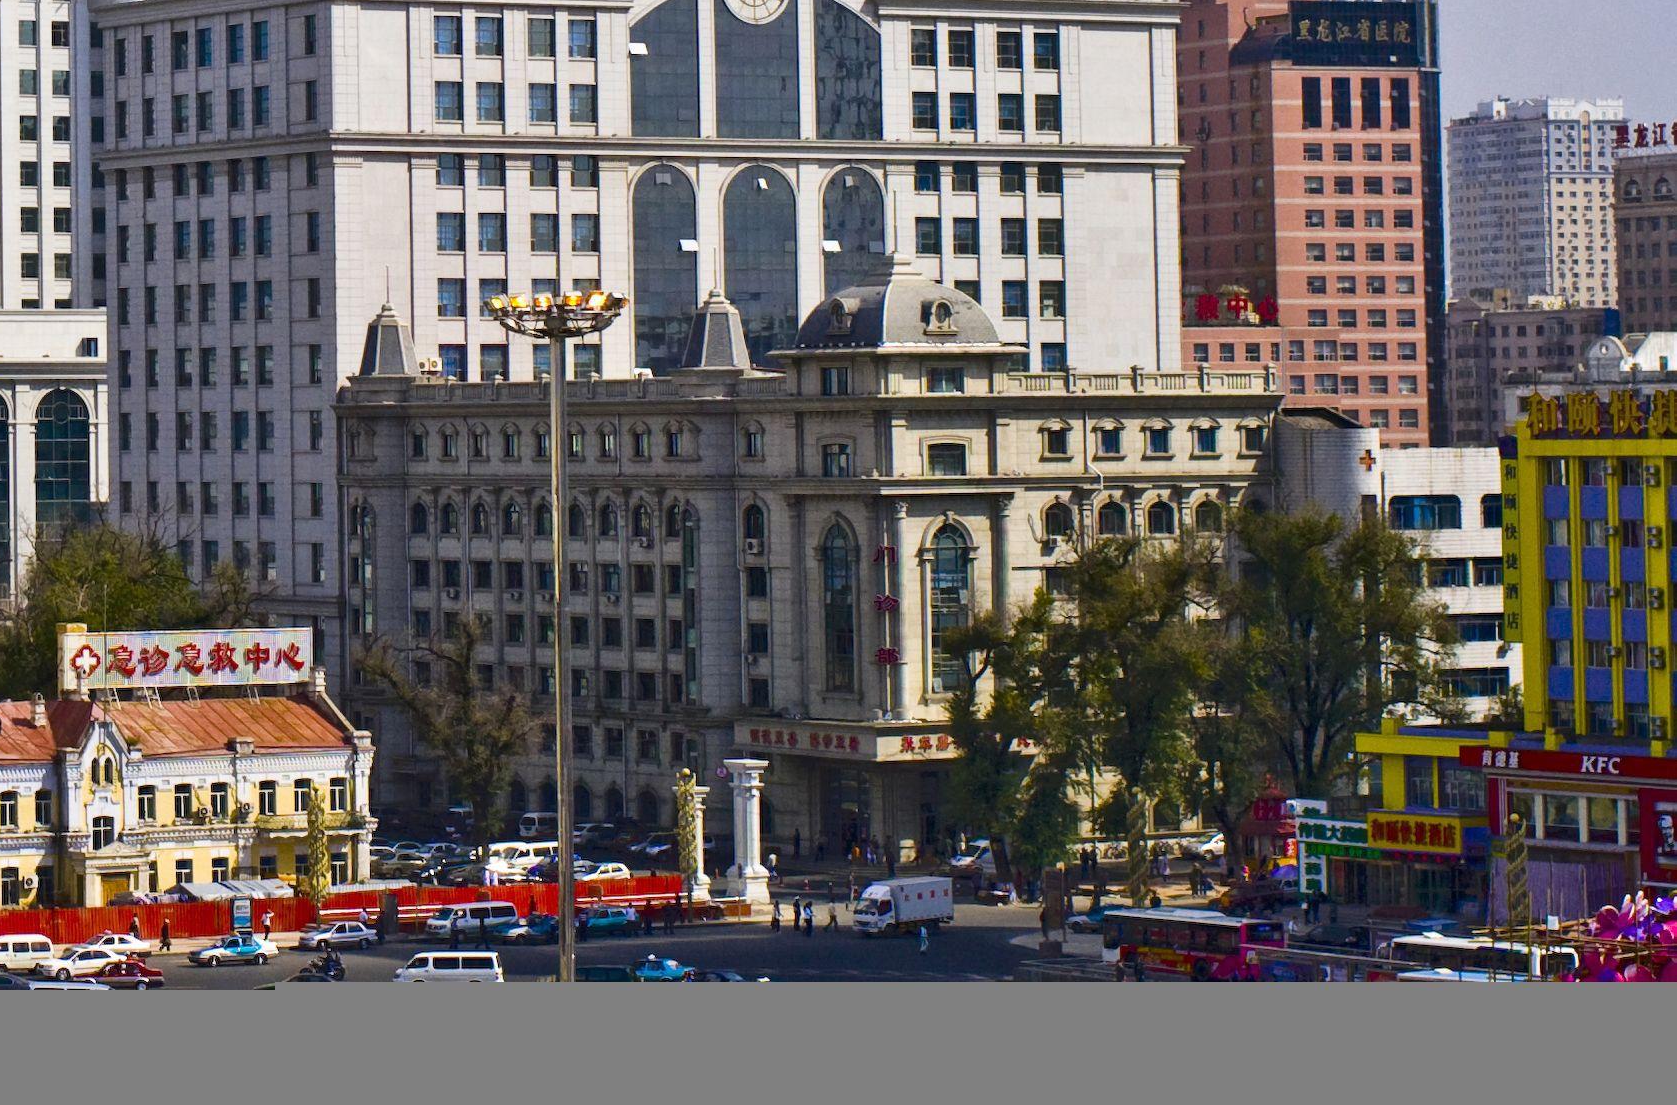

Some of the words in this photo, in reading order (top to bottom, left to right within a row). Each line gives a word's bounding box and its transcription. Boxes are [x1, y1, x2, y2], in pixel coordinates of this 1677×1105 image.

[1296, 18, 1411, 44] 黑龙江省医院
[1612, 121, 1677, 149] 黑龙江
[1503, 463, 1520, 631] 和颐快捷酒店
[107, 641, 306, 678] 急诊急救中心
[1481, 749, 1520, 769] 肯德基
[1580, 755, 1622, 775] KFC
[1370, 818, 1457, 849] 和颐快捷酒店
